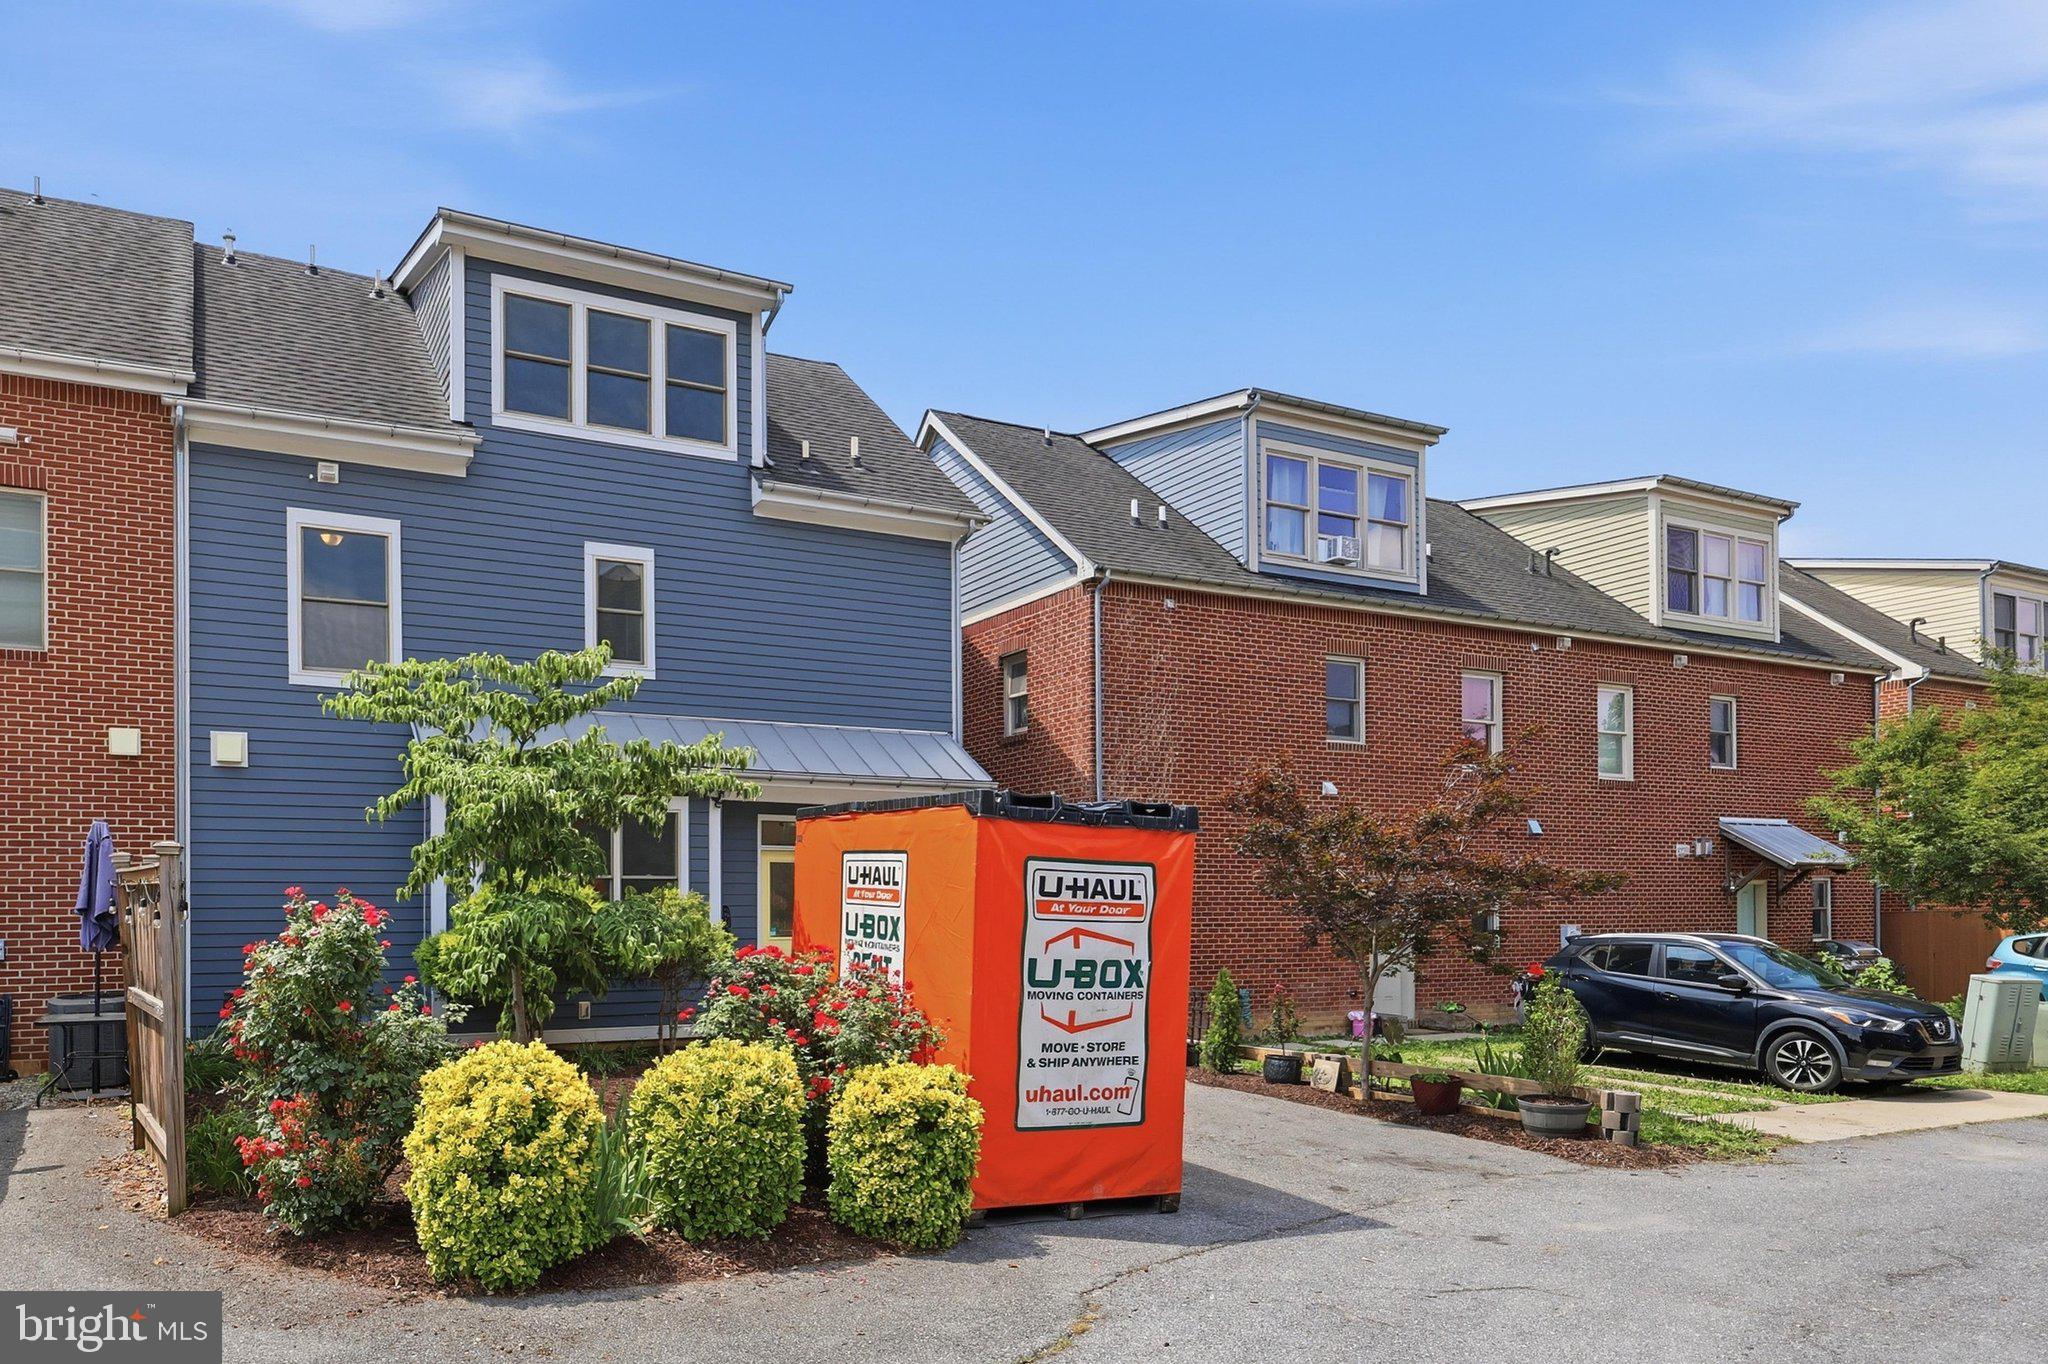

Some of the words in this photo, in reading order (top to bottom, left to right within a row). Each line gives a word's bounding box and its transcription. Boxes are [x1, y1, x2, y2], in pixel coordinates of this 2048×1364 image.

[848, 865, 899, 886] U-HAUL
[1038, 875, 1142, 901] U-HAUL
[1050, 903, 1065, 913] At
[1068, 903, 1097, 914] Your
[1099, 905, 1132, 915] Door
[846, 911, 901, 942] U-BOX
[1027, 957, 1144, 989] U-BOX
[1027, 990, 1074, 1001] MOVING
[1077, 990, 1144, 1001] CONTAINERS
[1041, 1042, 1079, 1053] MOVE
[1086, 1041, 1126, 1053] STORE
[1026, 1058, 1036, 1068] &
[1038, 1057, 1070, 1068] SHIP
[1071, 1056, 1139, 1067] ANYWHERE
[1025, 1084, 1131, 1103] uhaul.com
